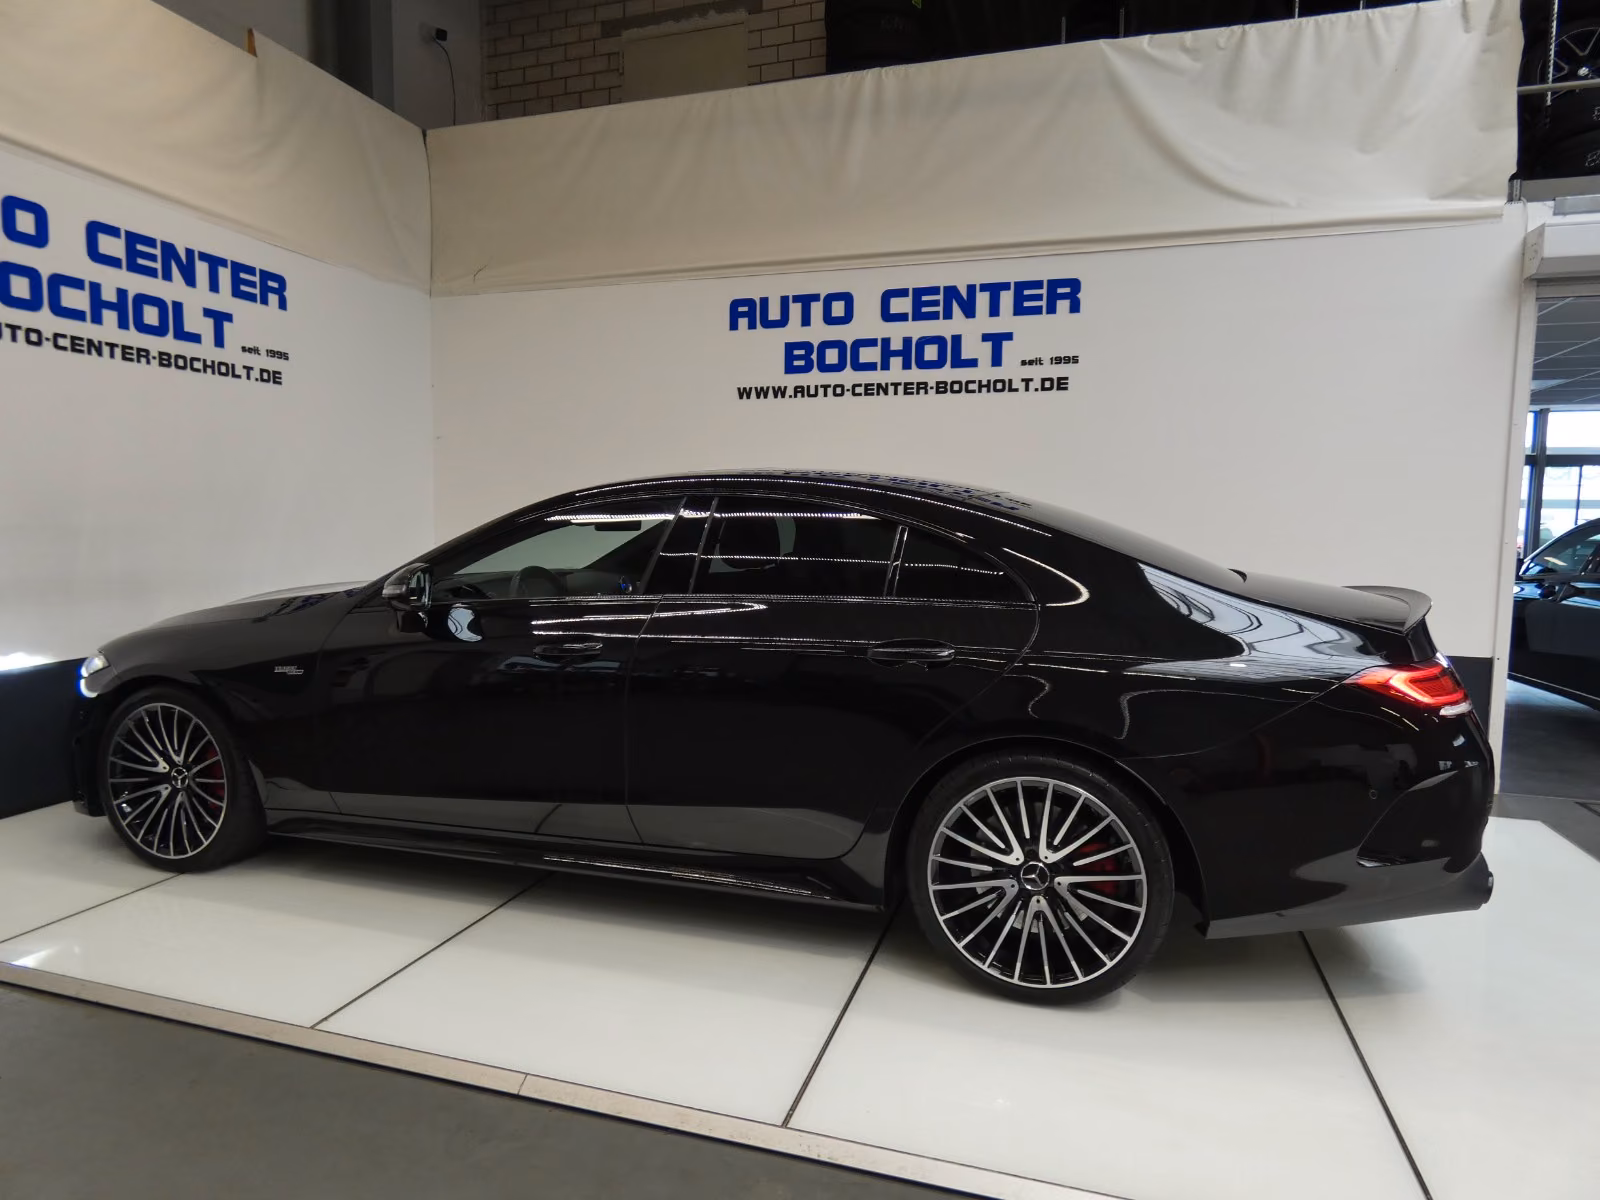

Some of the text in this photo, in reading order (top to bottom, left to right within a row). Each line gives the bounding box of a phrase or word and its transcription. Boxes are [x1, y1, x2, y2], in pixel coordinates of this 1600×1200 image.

[85, 220, 288, 312] CENTER
[729, 277, 1082, 331] AUTO CENTER
[240, 344, 290, 361] seit 1995
[784, 331, 1014, 375] BOCHOLT
[1020, 355, 1080, 367] seit 1995
[737, 376, 1070, 400] WWW.AUTO-CENTER-BOCHOLT.DE
